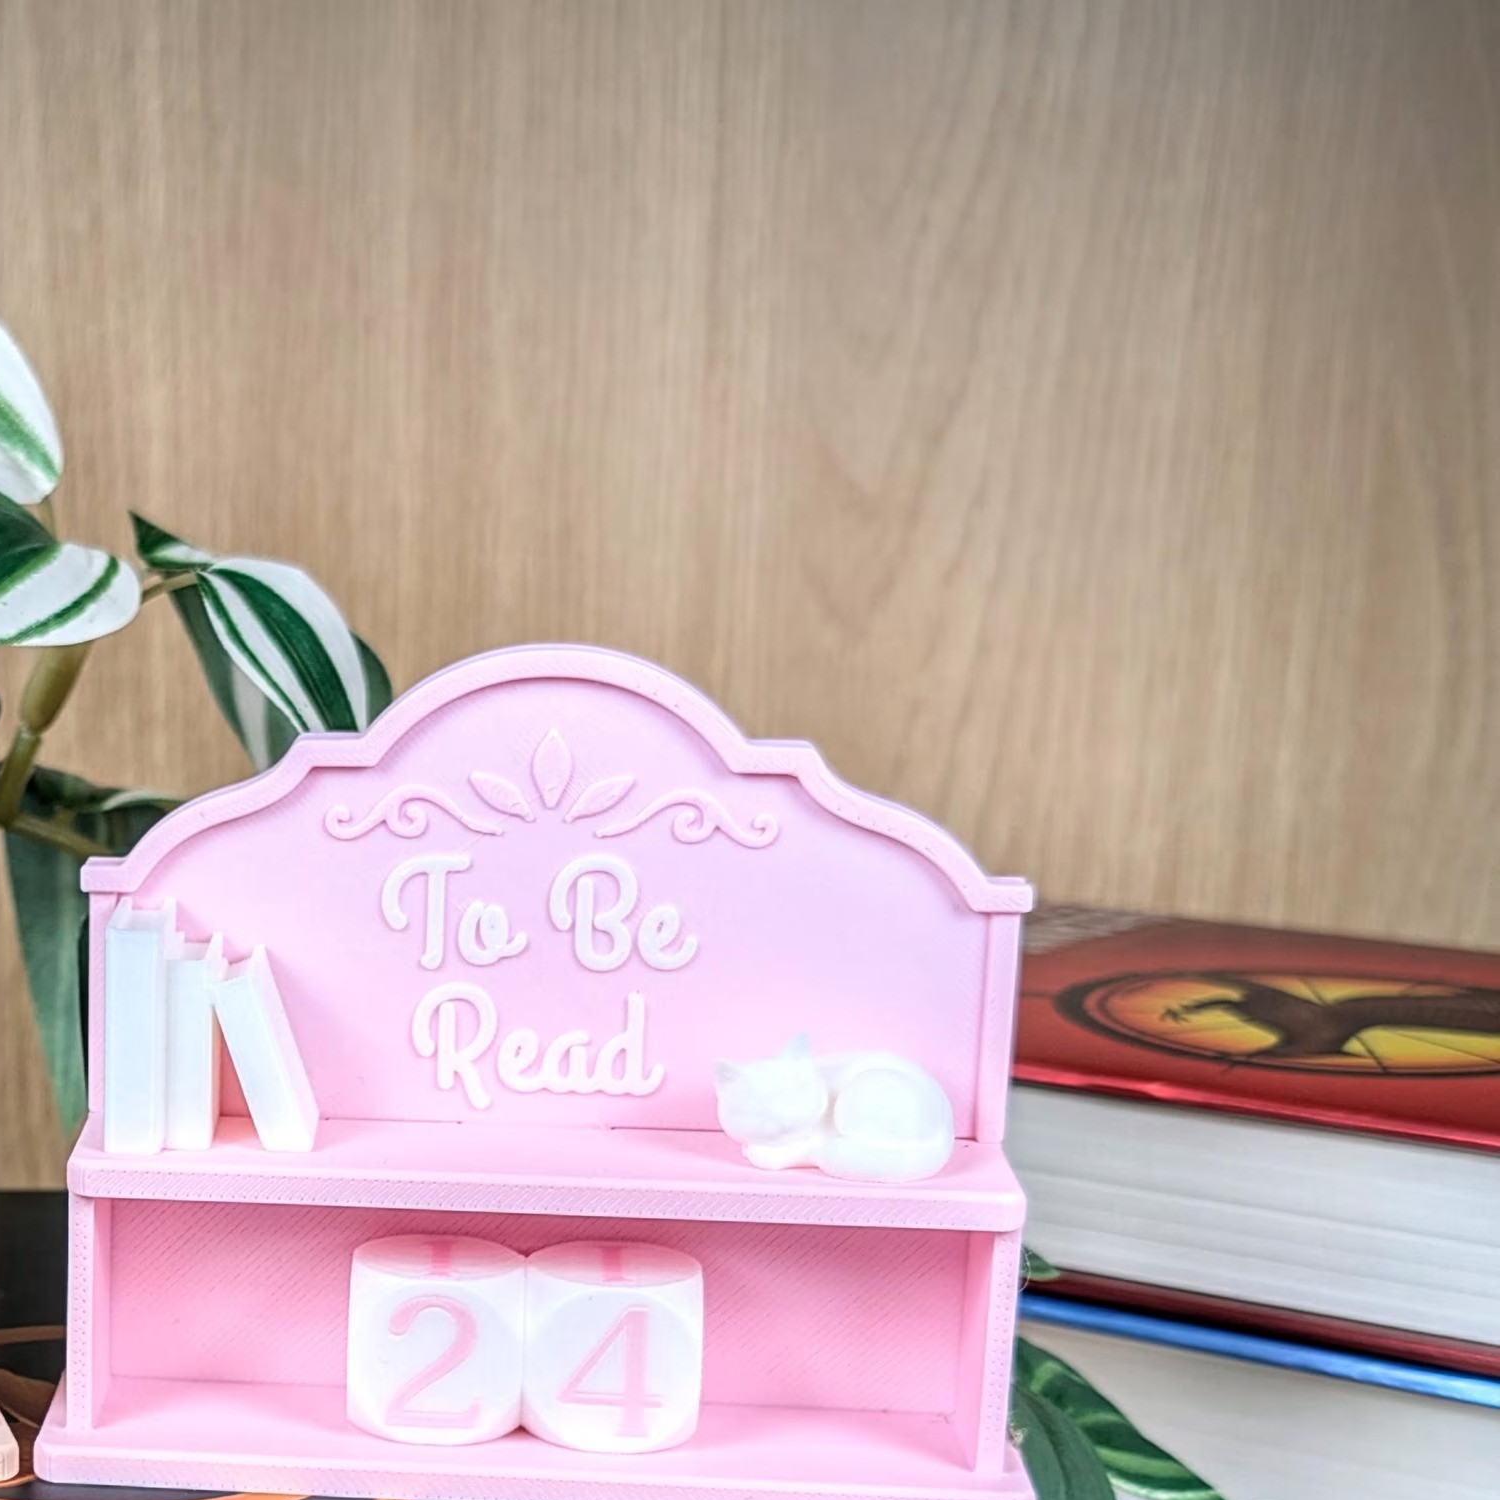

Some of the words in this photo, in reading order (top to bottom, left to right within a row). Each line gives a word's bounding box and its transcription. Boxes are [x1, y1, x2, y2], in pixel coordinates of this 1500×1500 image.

[381, 853, 528, 970] To
[549, 852, 699, 973] Be
[412, 981, 665, 1110] Read
